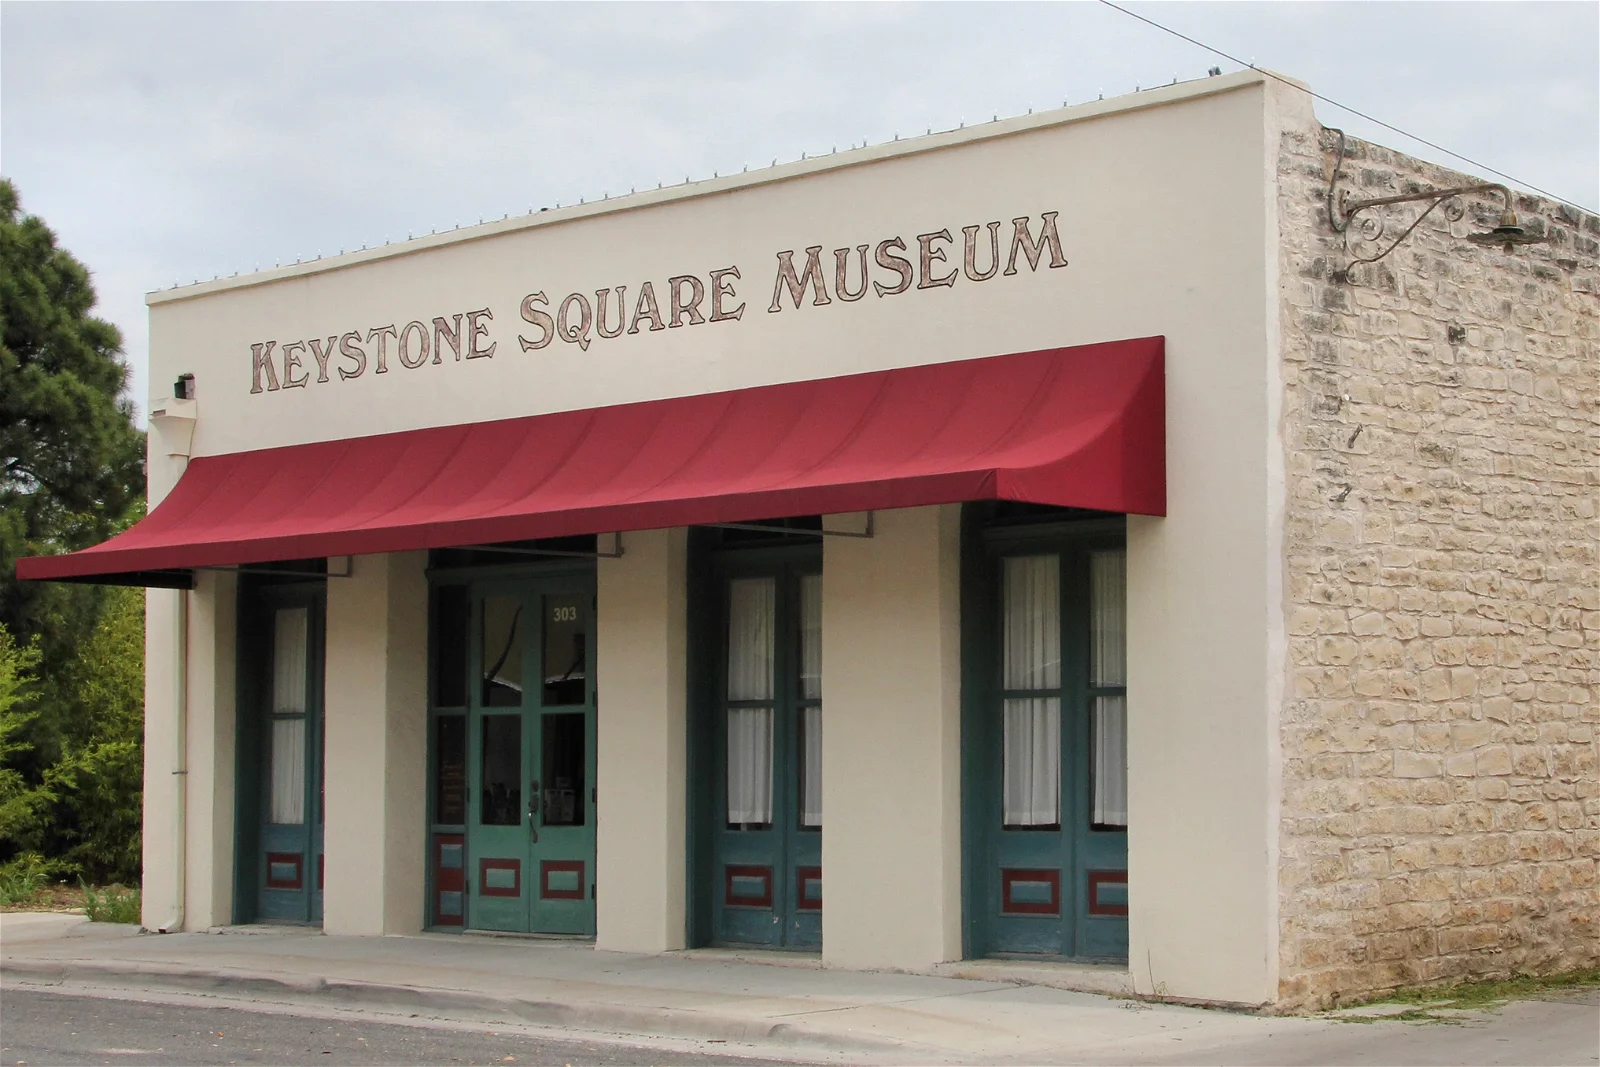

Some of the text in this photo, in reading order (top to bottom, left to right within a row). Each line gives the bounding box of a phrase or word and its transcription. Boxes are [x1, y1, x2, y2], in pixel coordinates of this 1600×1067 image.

[250, 211, 1068, 394] KEYSTONE SQUARE MUSEUM
[553, 606, 577, 622] 303
